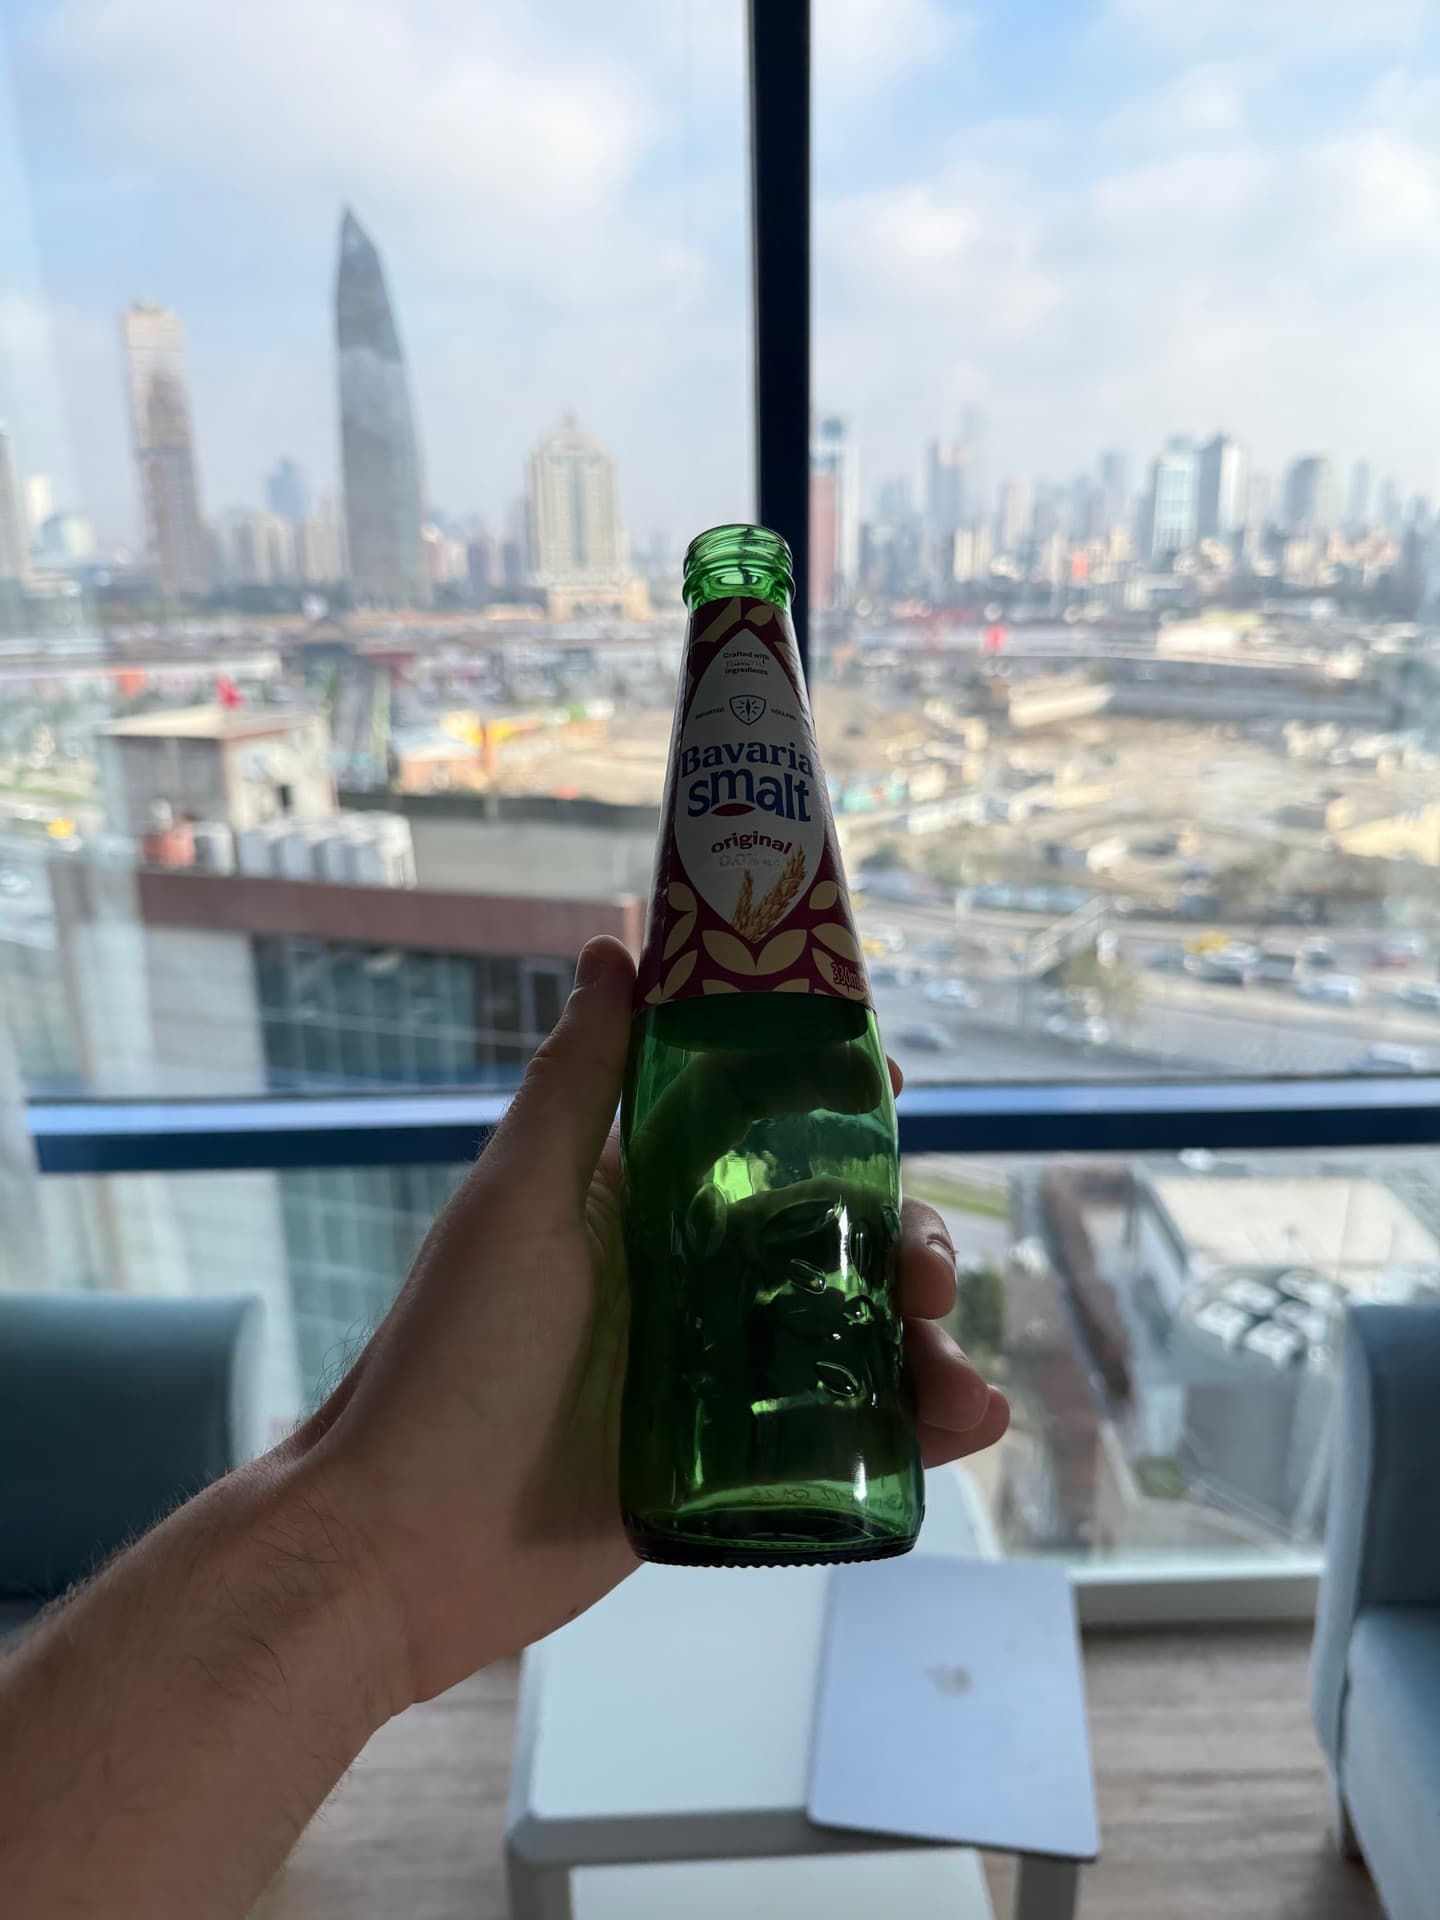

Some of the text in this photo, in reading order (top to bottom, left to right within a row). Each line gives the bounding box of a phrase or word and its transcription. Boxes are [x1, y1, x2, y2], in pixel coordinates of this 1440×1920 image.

[723, 651, 752, 659] Crafted
[681, 742, 814, 779] Bavaria
[688, 768, 811, 822] smalt
[711, 830, 792, 855] original
